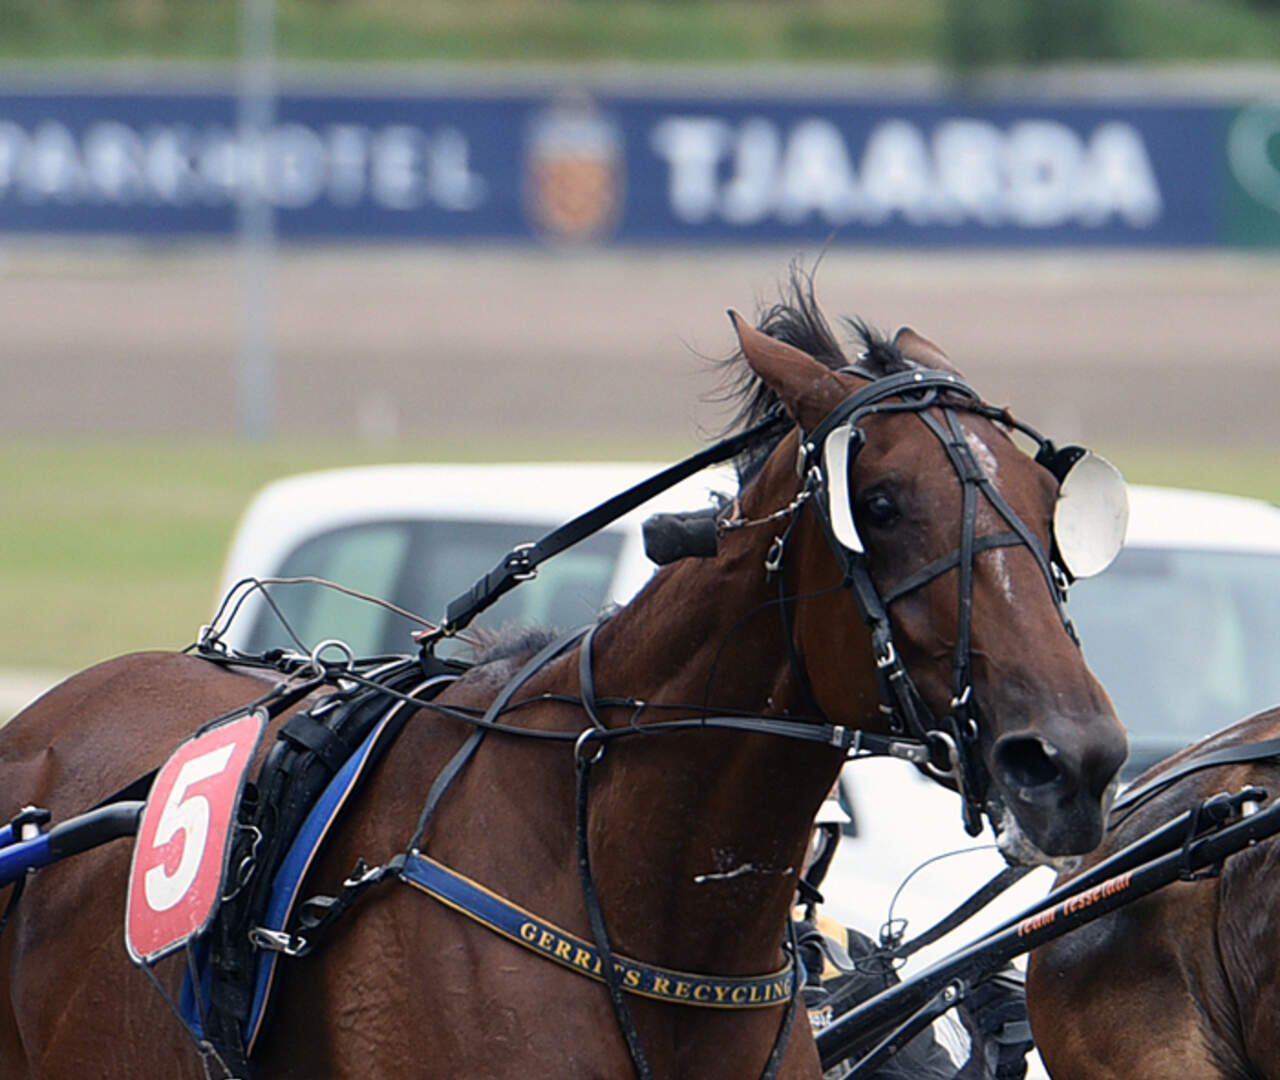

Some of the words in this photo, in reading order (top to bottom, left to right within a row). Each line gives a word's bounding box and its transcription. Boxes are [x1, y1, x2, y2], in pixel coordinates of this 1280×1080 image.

[656, 118, 1162, 228] TJAARDA
[145, 744, 236, 912] 5
[520, 921, 640, 988] GERRIS
[652, 976, 792, 1003] RECYCLING
